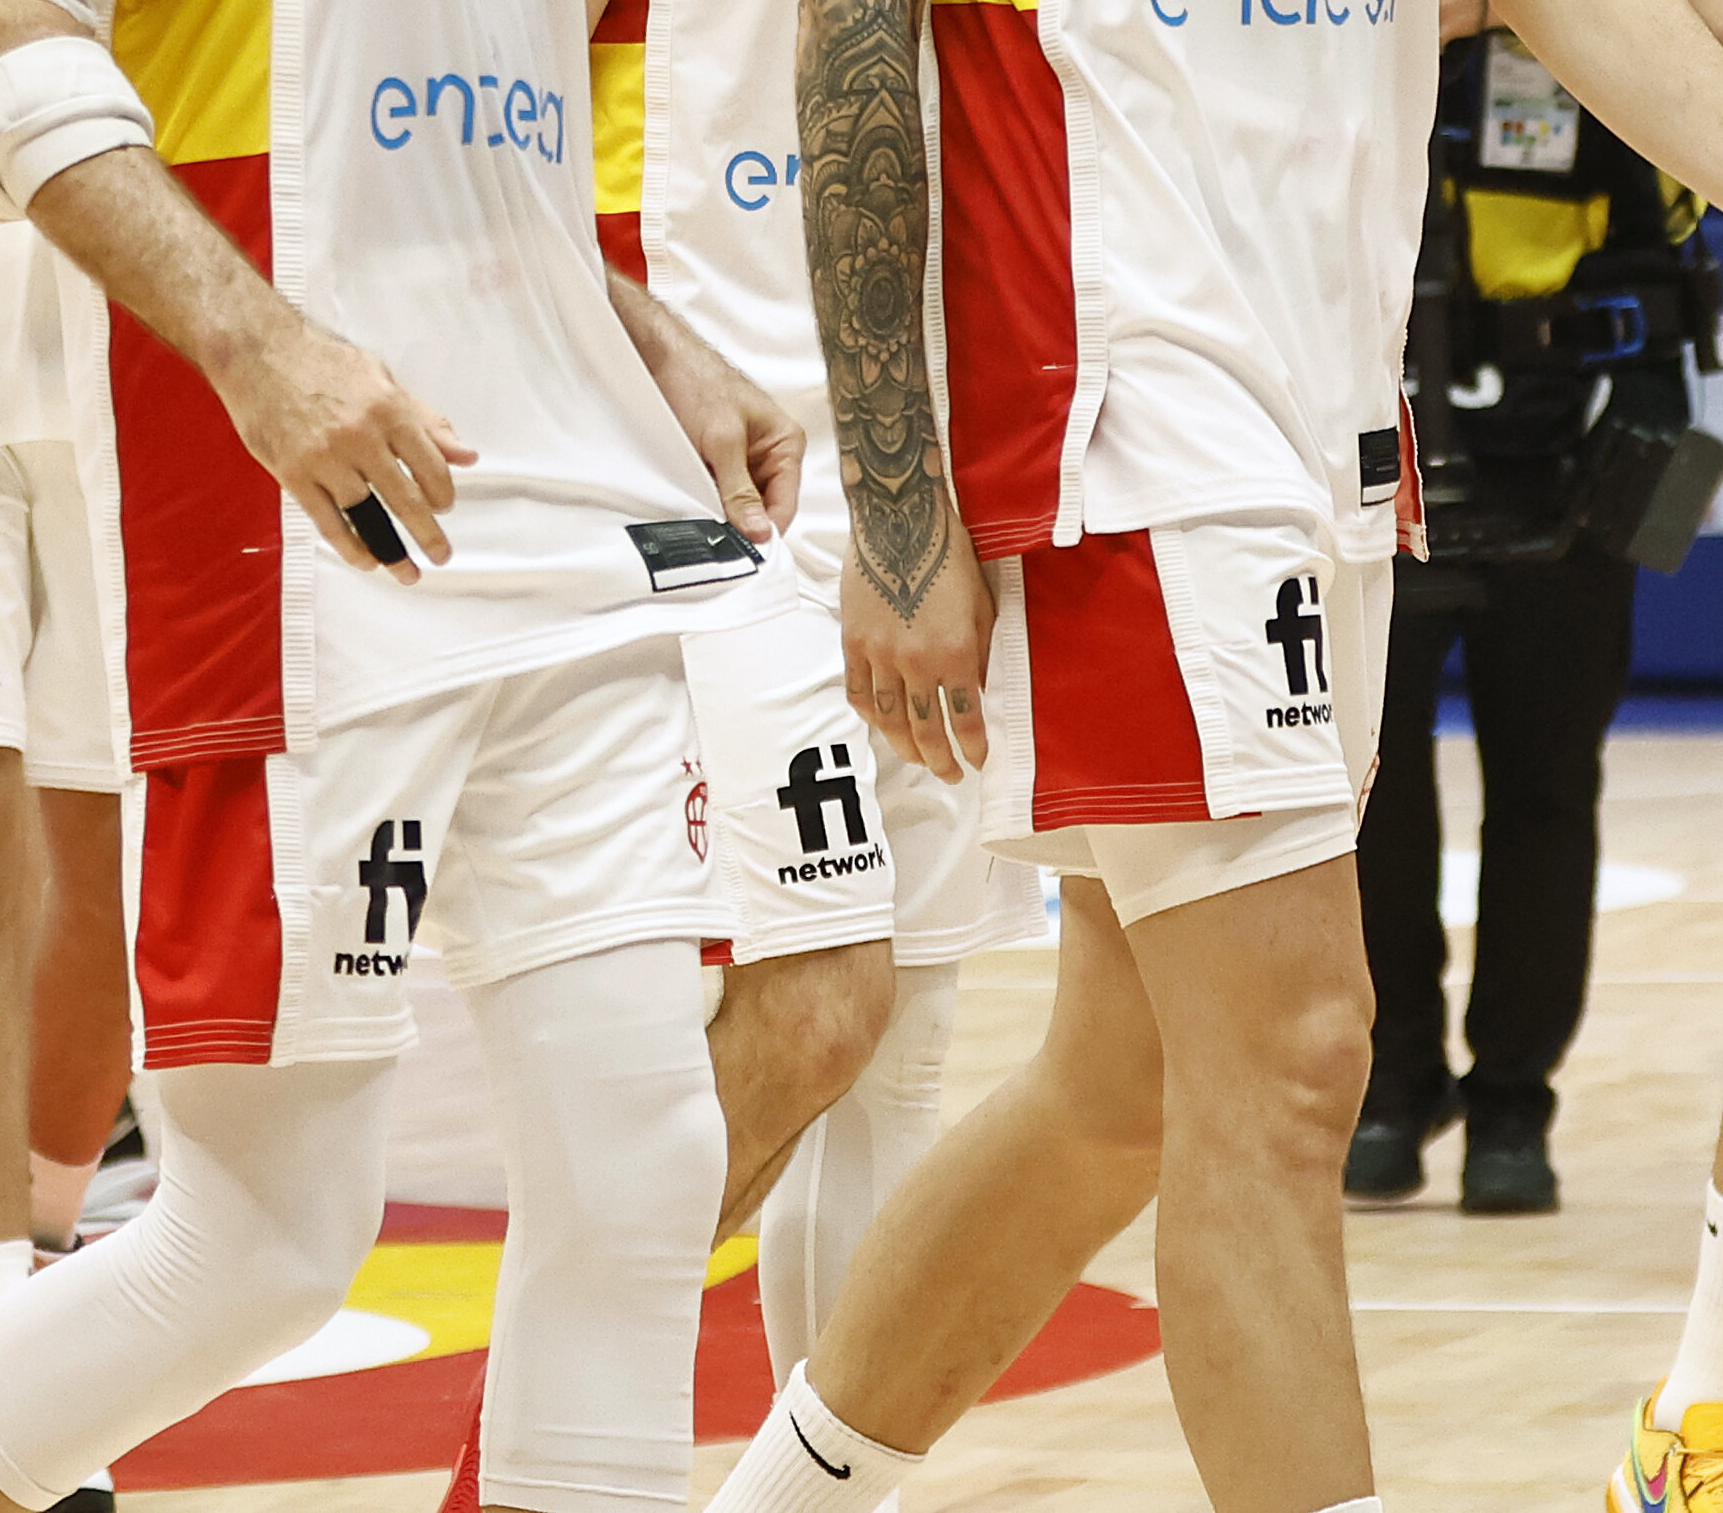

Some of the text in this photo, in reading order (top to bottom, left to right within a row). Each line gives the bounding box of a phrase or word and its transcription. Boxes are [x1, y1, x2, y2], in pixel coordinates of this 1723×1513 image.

[777, 743, 869, 855] fi
[358, 819, 428, 944] fi
[778, 843, 886, 886] network
[333, 951, 409, 977] netw
